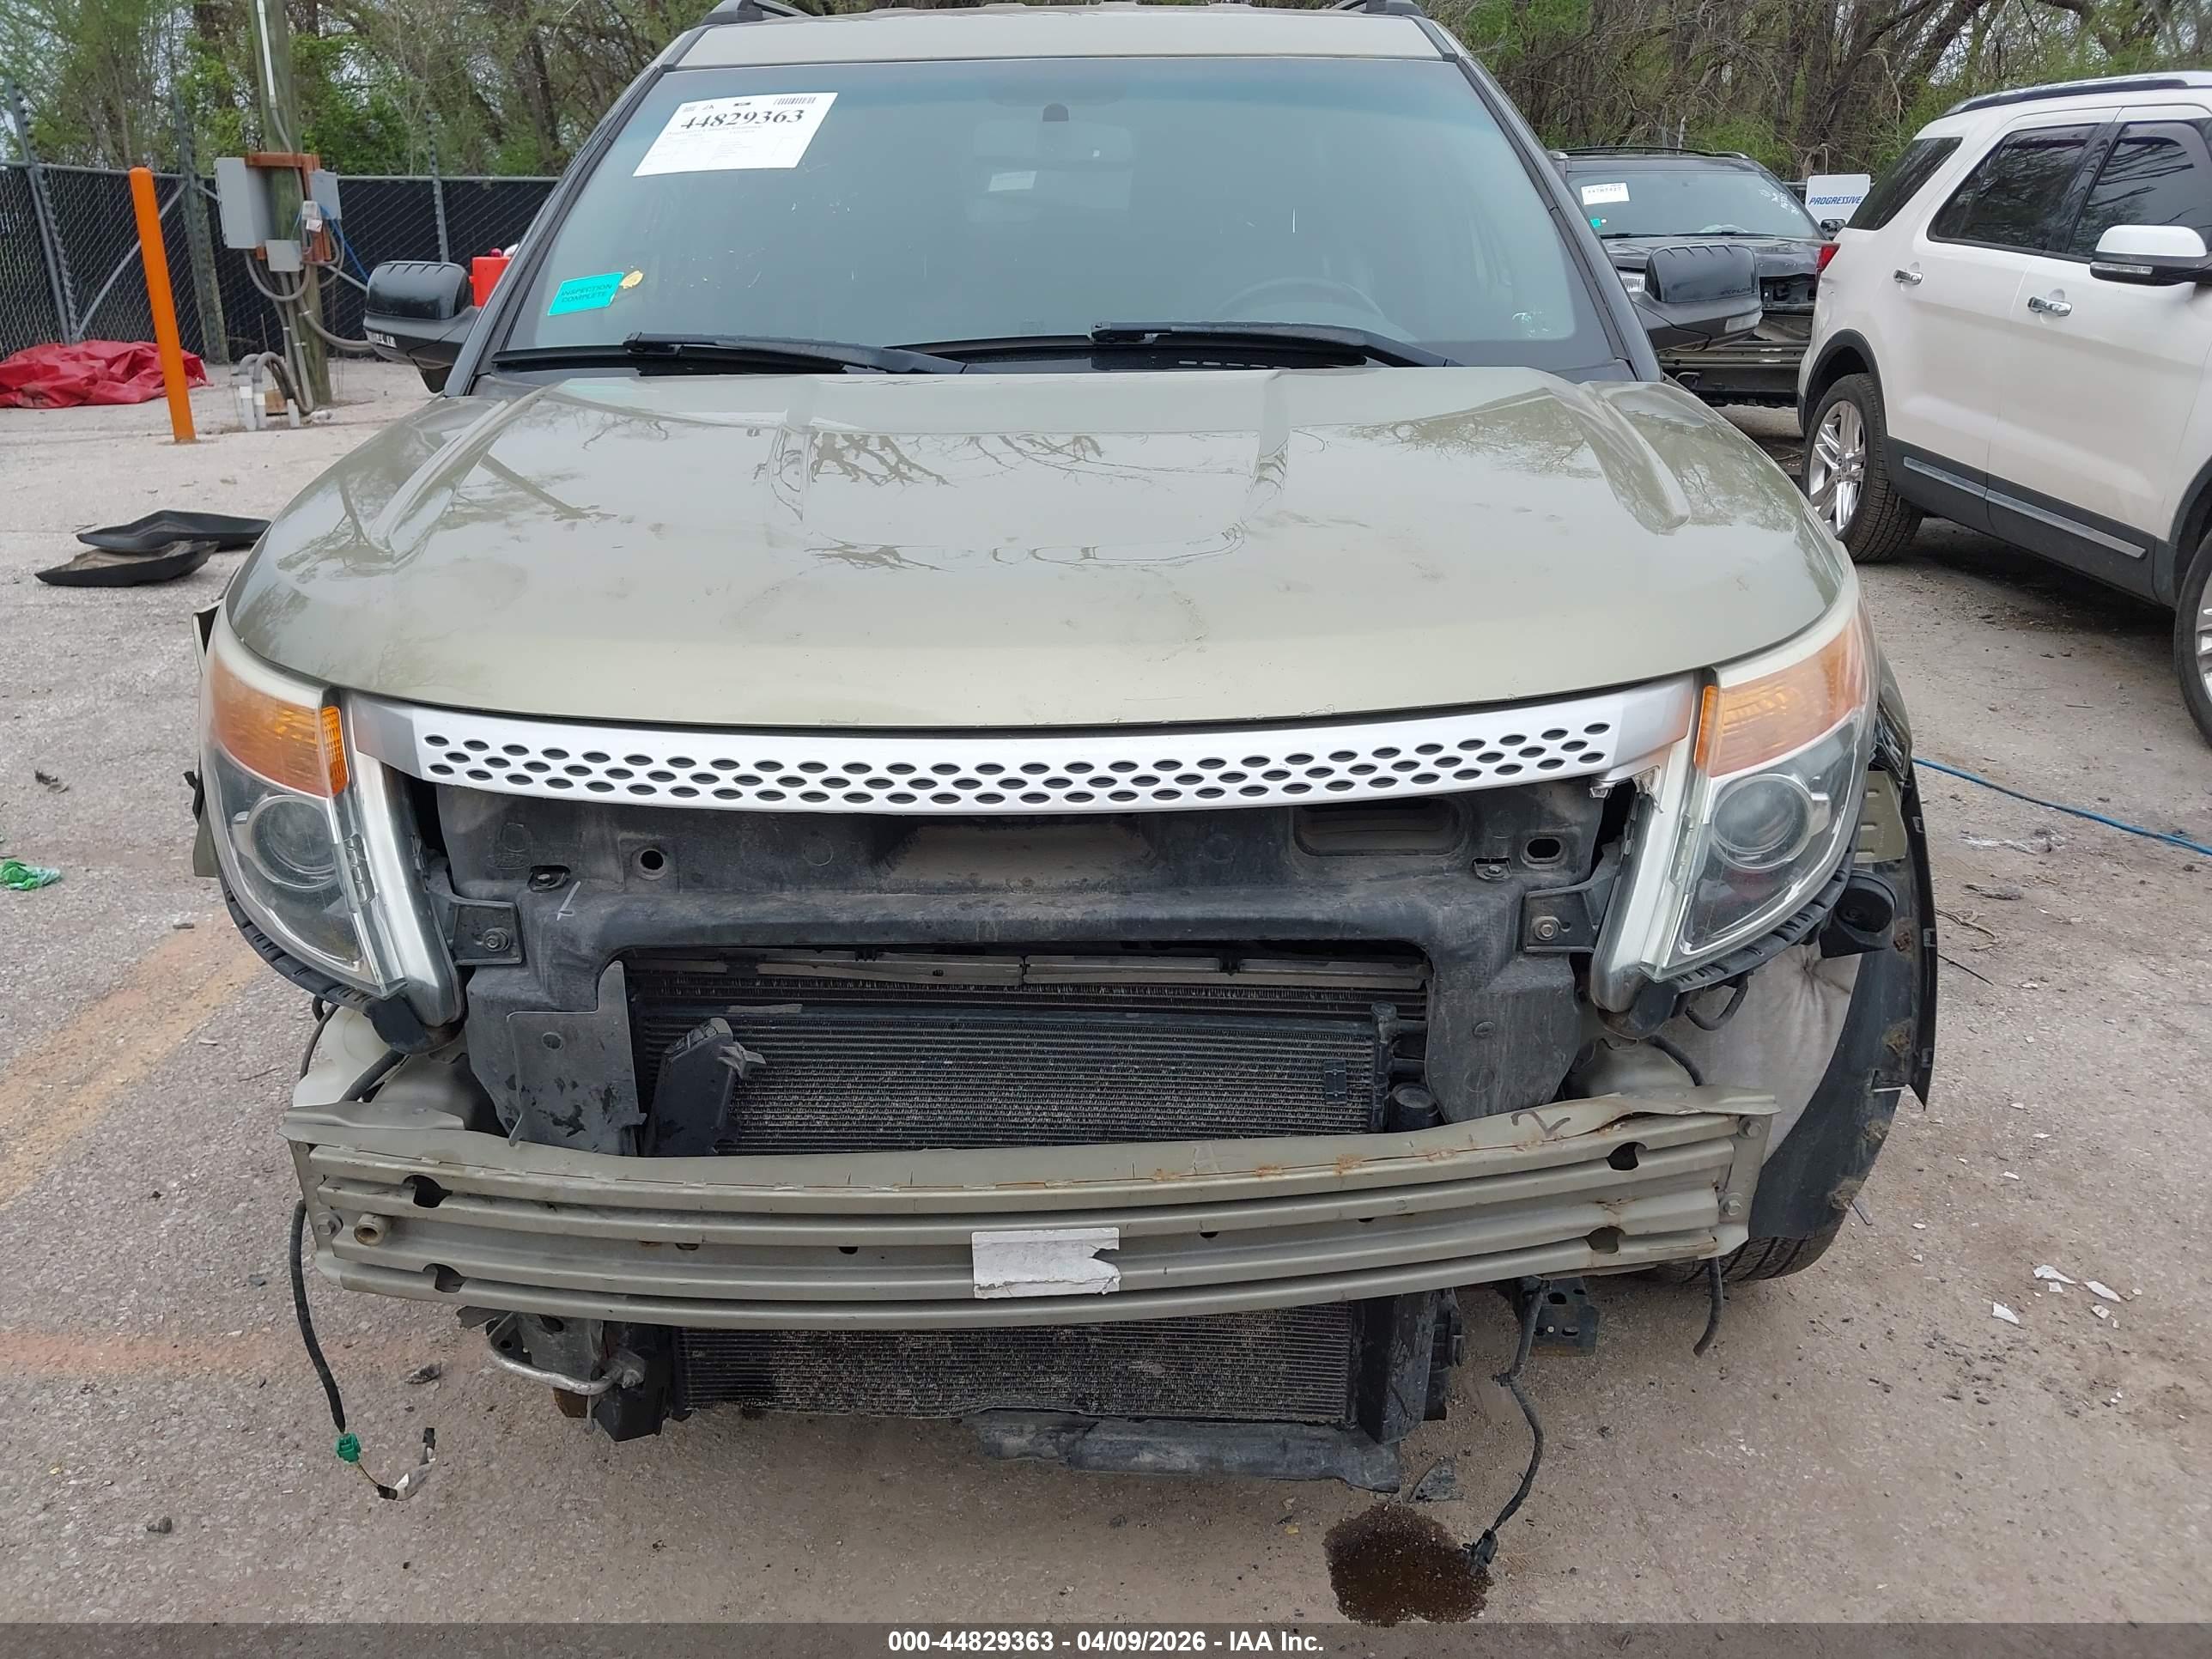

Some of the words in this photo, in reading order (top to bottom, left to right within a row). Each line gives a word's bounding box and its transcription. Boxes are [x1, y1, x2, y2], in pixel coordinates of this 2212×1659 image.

[680, 109, 805, 130] 44829363
[1808, 196, 1863, 205] PROGRESSIVE
[561, 283, 612, 296] INSPECTION
[561, 291, 607, 303] COMPLETE
